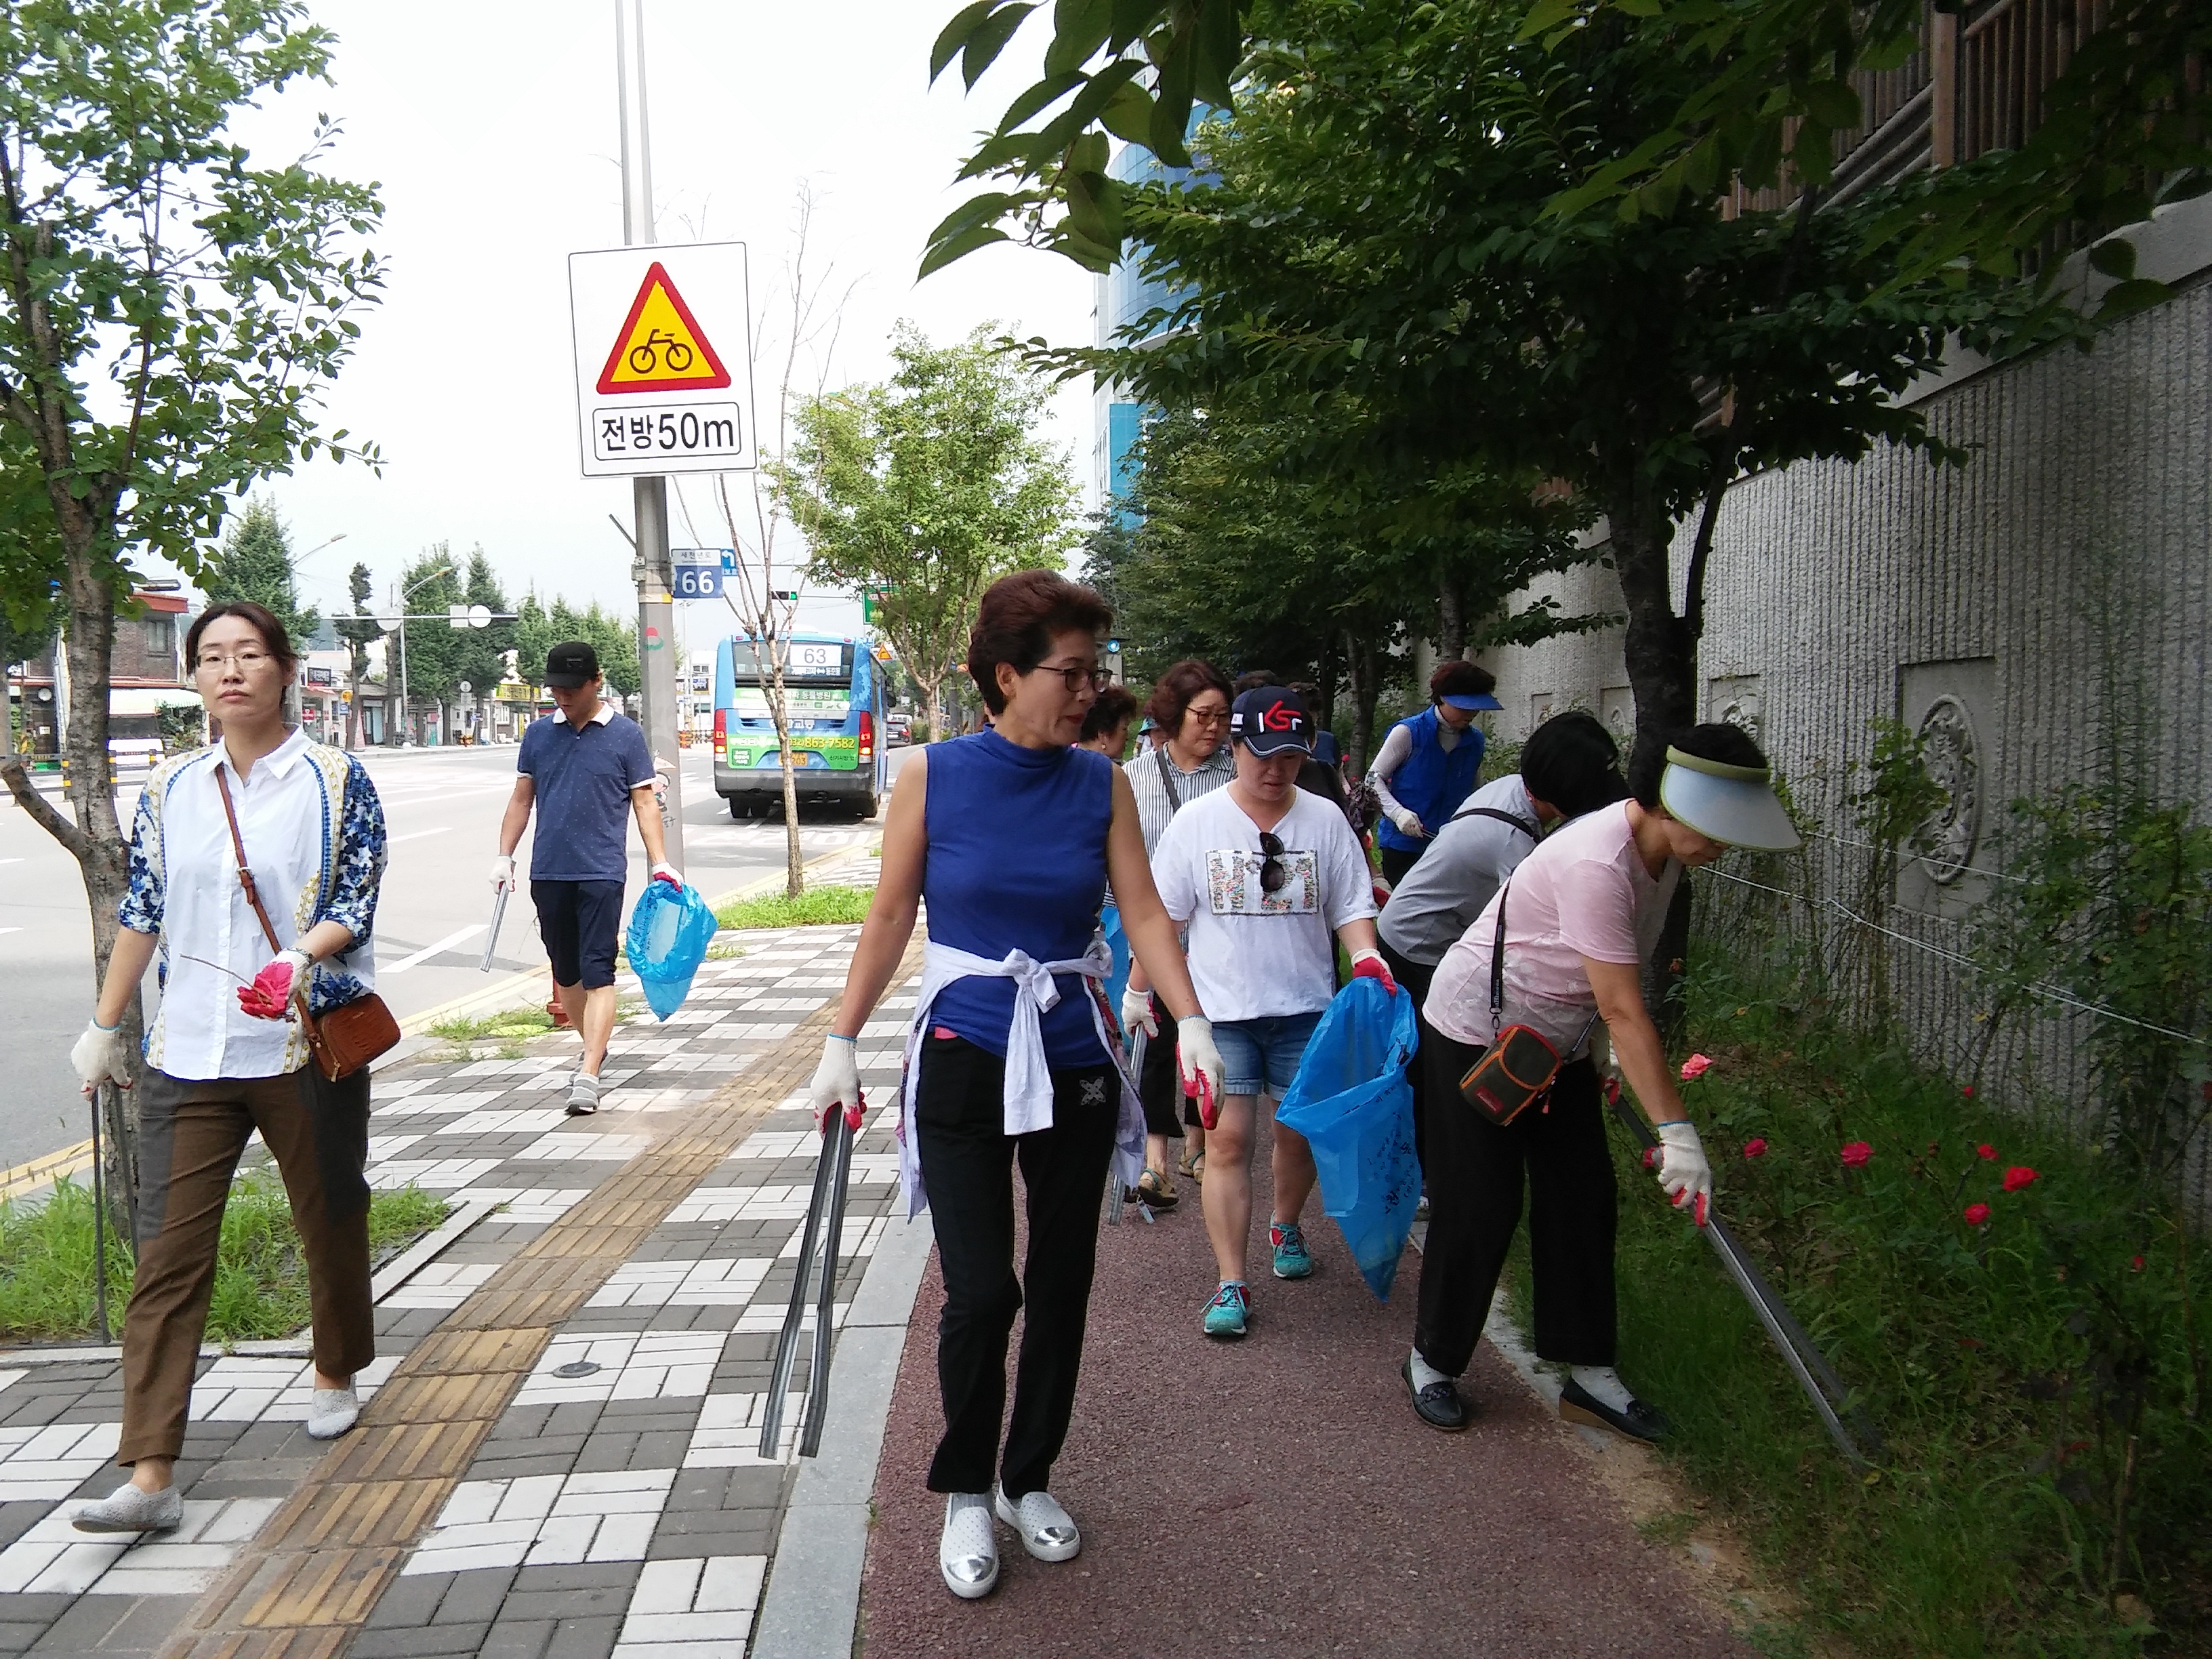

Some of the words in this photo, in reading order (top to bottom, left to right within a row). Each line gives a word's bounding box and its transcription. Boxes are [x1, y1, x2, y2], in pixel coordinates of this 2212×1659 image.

[601, 412, 735, 451] 전방50m
[682, 571, 714, 594] 66
[804, 648, 826, 663] 63
[802, 691, 831, 700] 동물병원
